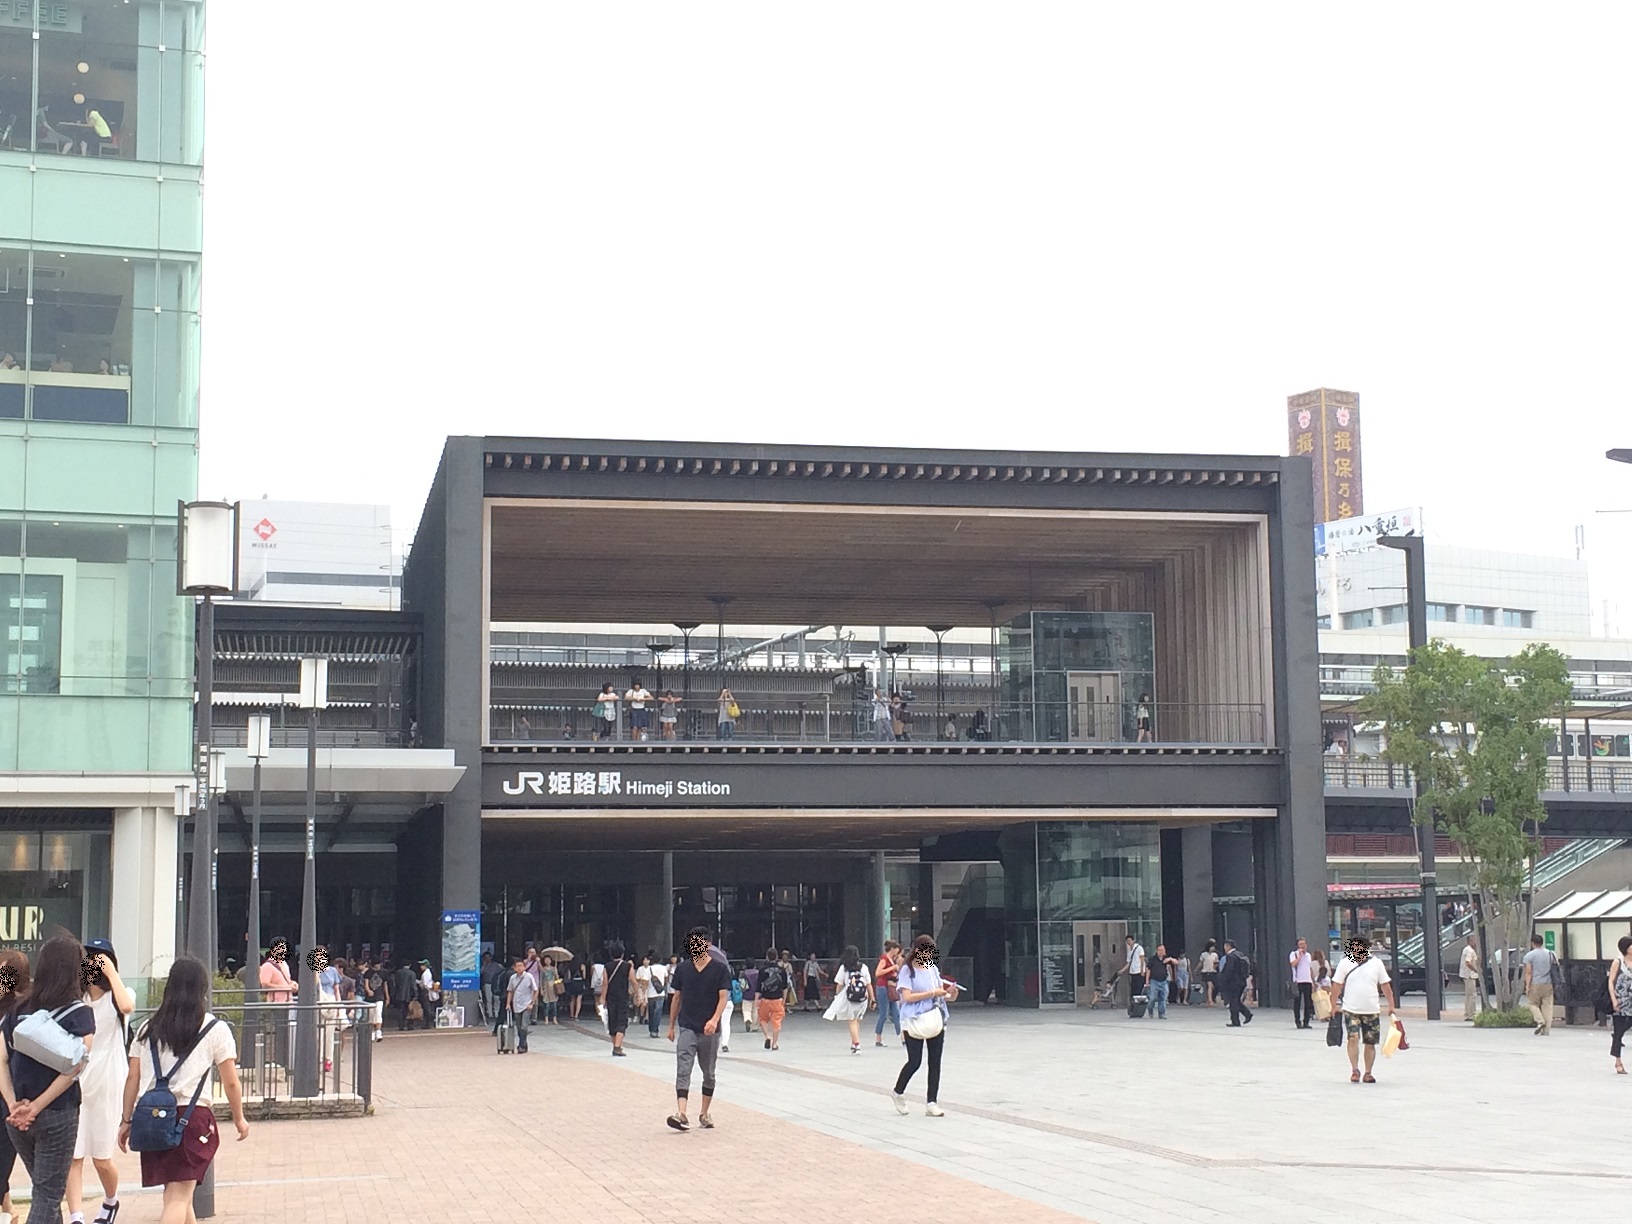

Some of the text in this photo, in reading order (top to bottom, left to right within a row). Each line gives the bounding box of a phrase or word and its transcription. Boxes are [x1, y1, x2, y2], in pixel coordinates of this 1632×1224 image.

[502, 771, 731, 798] JR 姫路駅 Himeji Station
